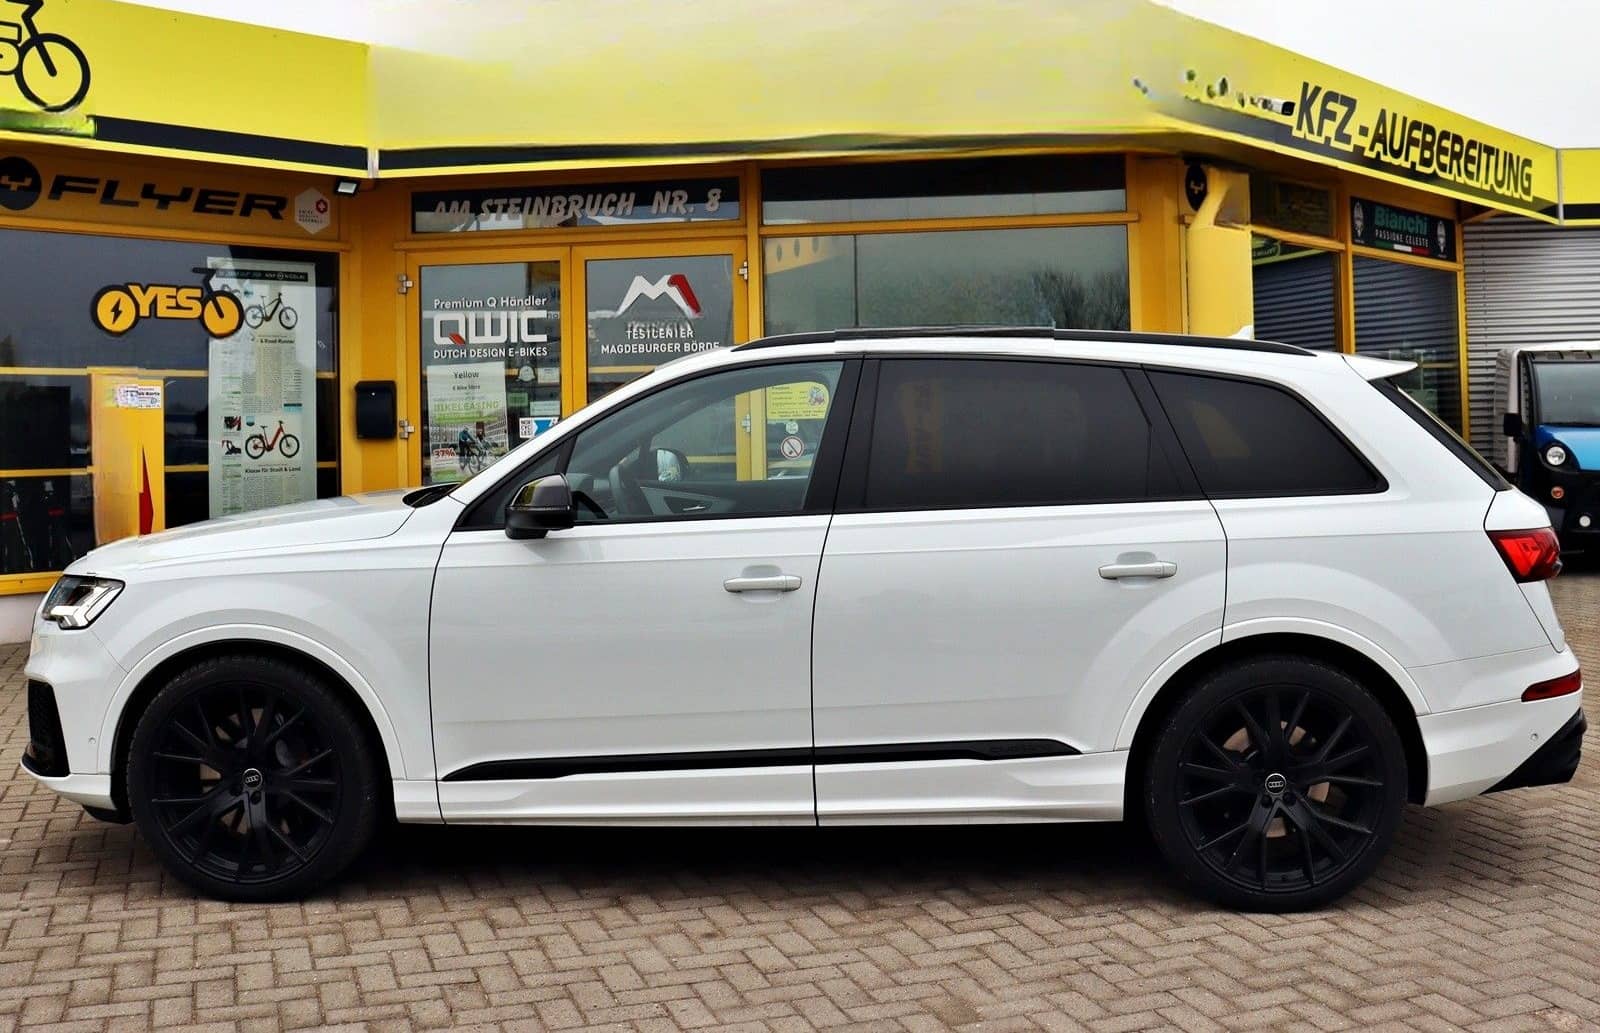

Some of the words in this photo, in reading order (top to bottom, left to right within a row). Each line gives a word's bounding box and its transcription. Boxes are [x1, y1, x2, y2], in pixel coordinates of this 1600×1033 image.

[48, 175, 287, 220] FLYER
[434, 199, 470, 224] AM
[480, 193, 635, 219] STEINBRUCH
[652, 190, 694, 215] NR.
[706, 188, 722, 213] 8
[1374, 206, 1428, 234] Bianchi
[1375, 229, 1404, 244] PASSIONE
[1405, 235, 1429, 248] CELESTE
[128, 284, 203, 319] YES
[433, 298, 484, 310] Premium
[487, 297, 497, 307] Q
[500, 296, 547, 307] Händler
[433, 310, 547, 345] QWIC
[433, 349, 467, 359] DUTCH
[470, 348, 506, 358] DESIGN
[508, 347, 548, 357] E-BIKES
[601, 343, 681, 354] MAGDEBURGER
[453, 370, 480, 379] Yellow
